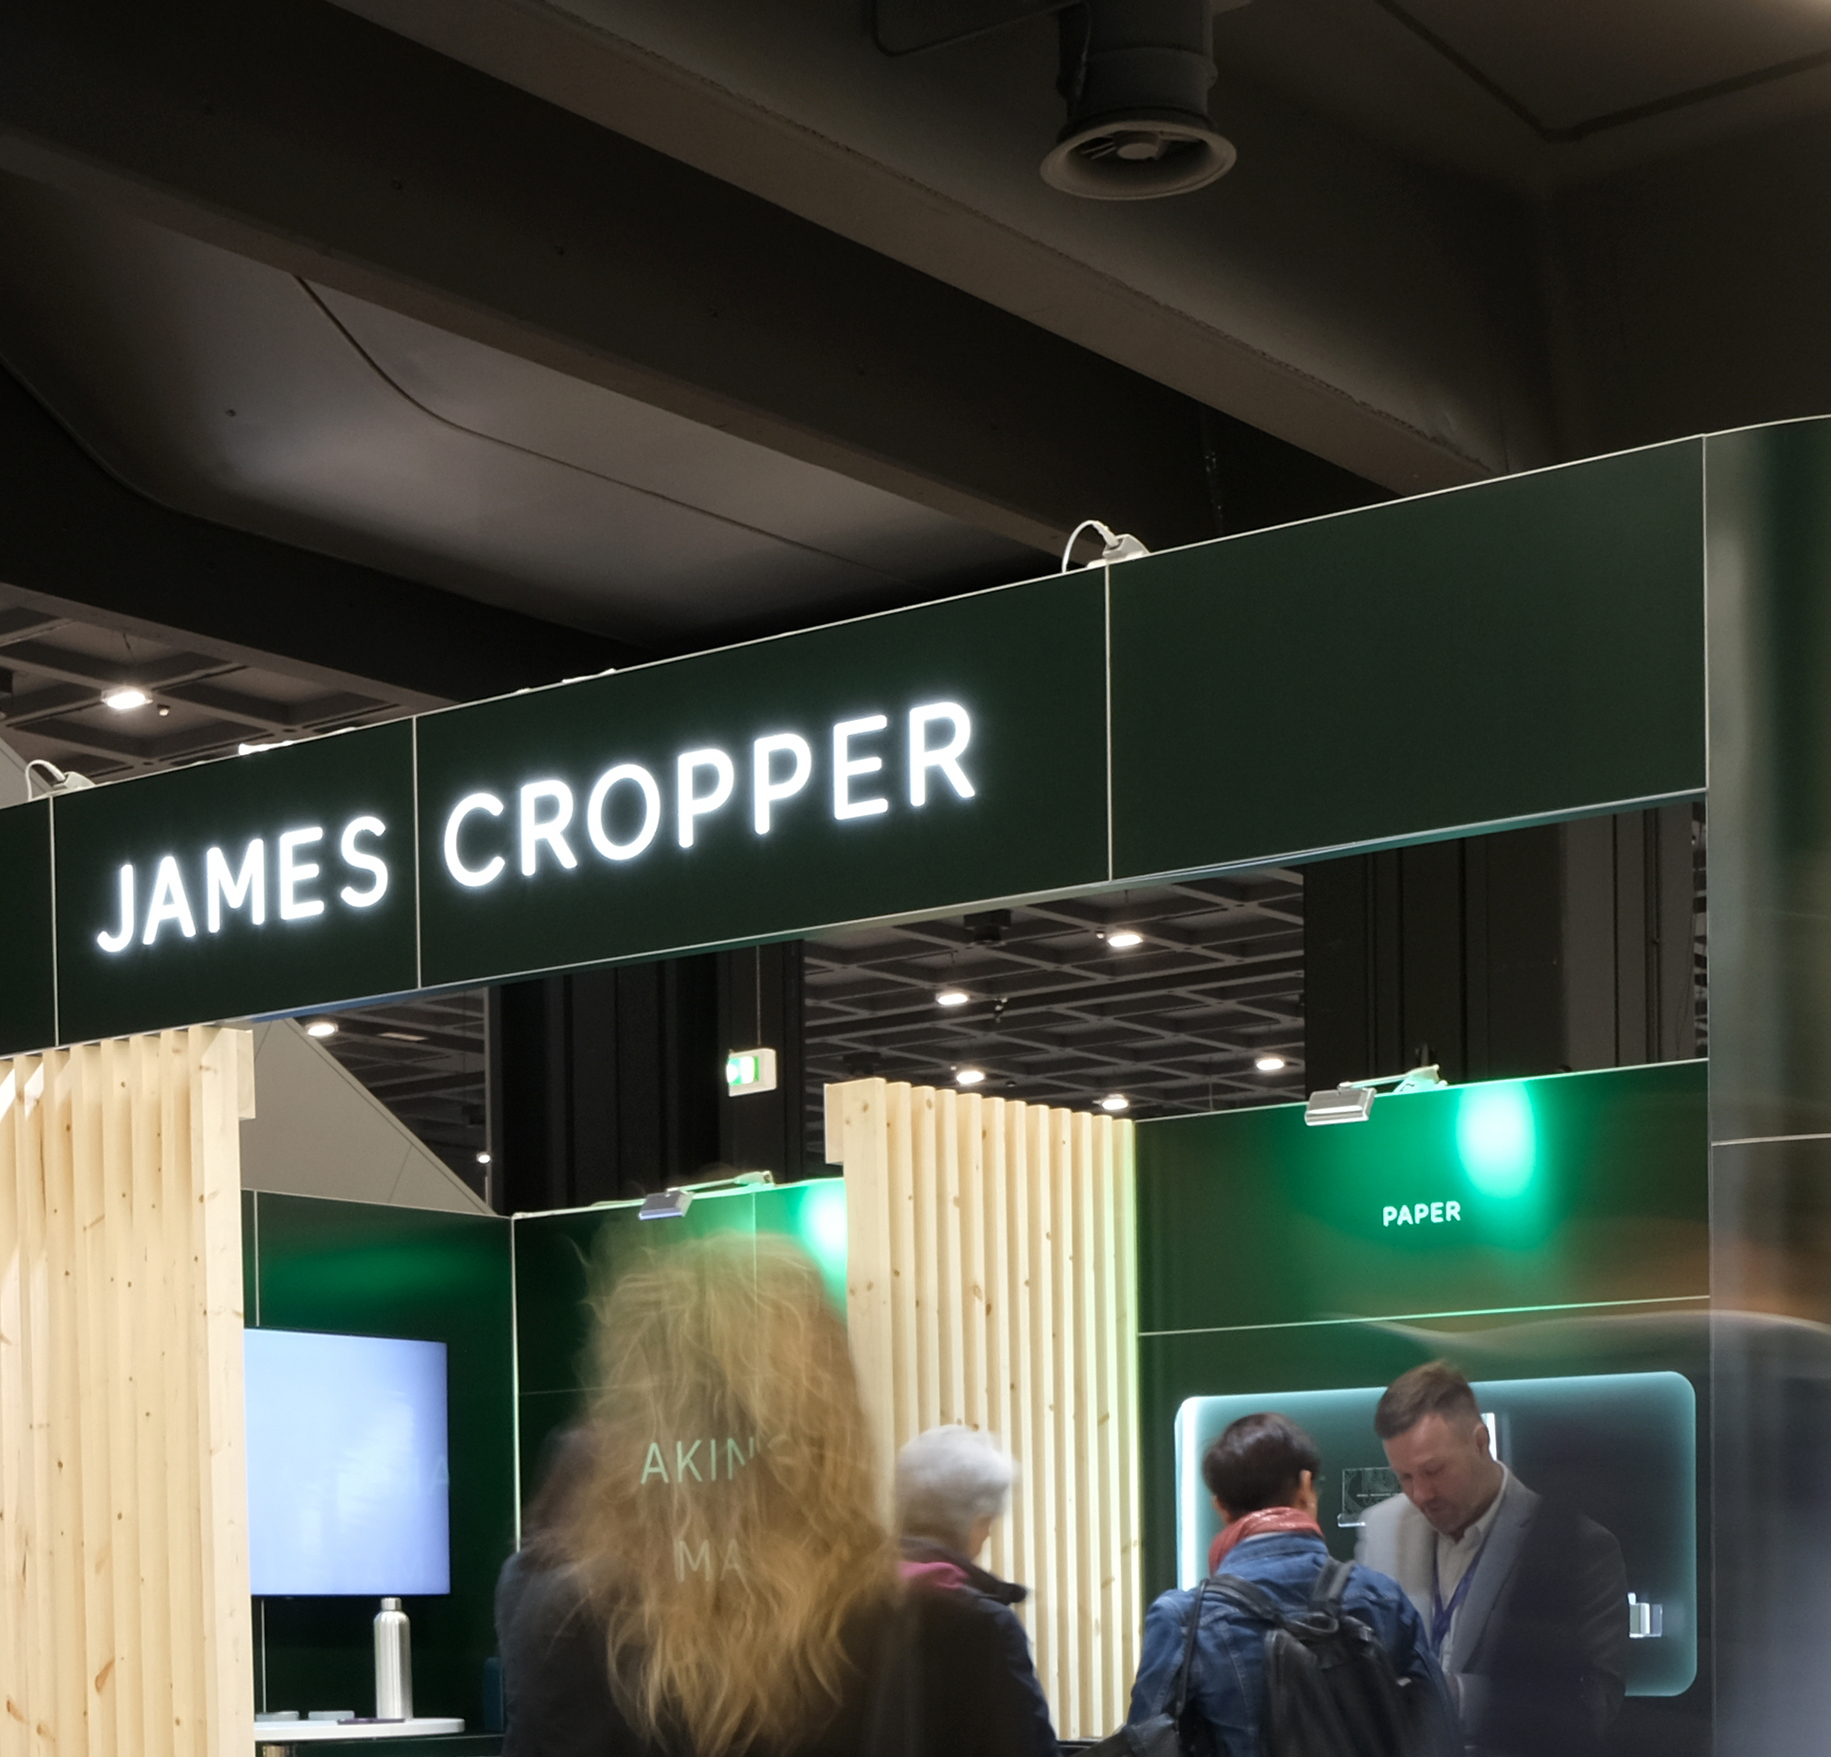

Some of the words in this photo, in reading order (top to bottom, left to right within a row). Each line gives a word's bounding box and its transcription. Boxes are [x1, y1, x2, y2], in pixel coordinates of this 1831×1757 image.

[95, 815, 390, 954] JAMES
[443, 700, 976, 889] CROPPER
[1382, 1200, 1462, 1228] PAPER
